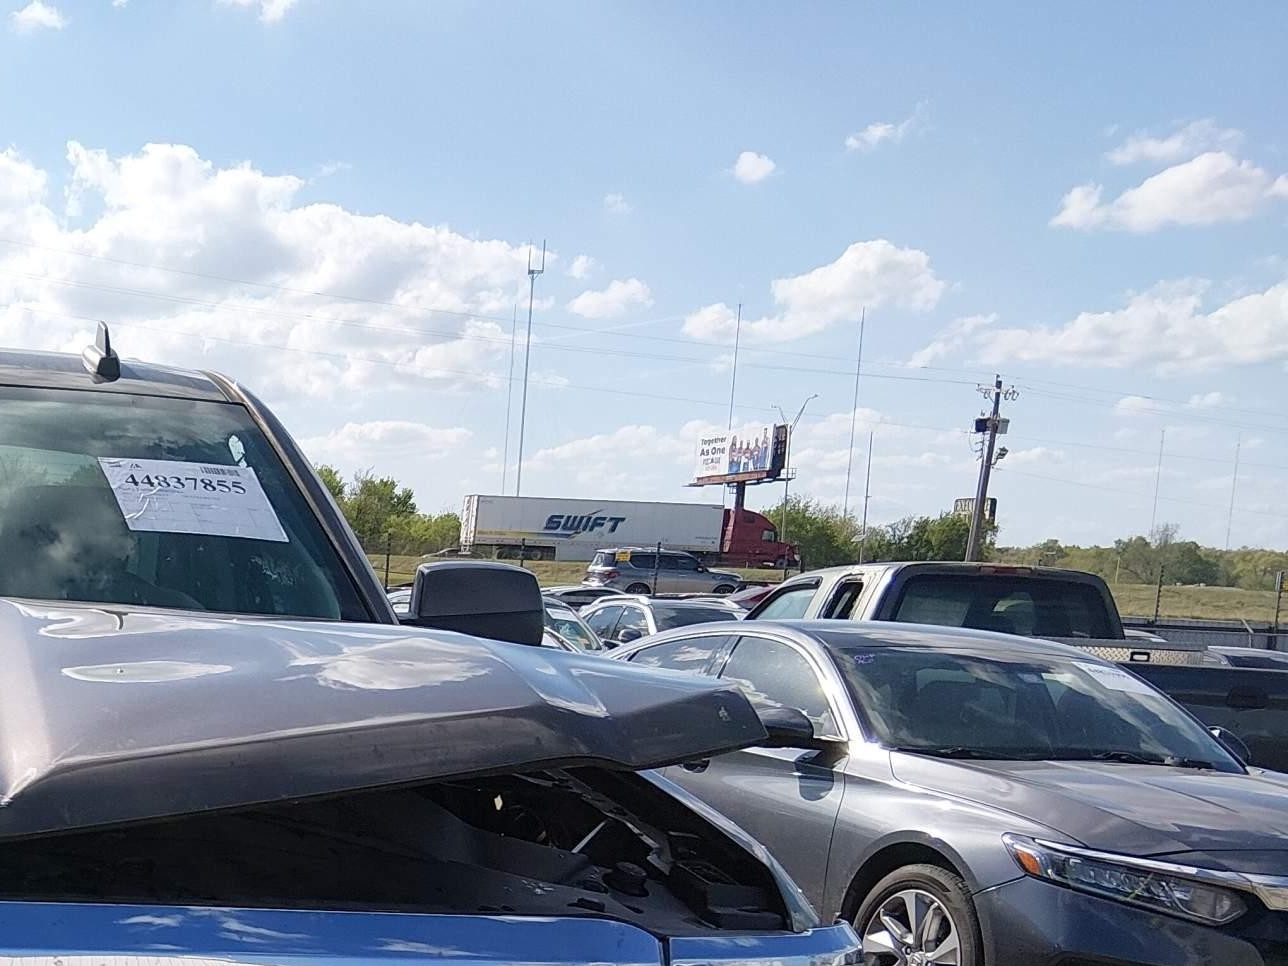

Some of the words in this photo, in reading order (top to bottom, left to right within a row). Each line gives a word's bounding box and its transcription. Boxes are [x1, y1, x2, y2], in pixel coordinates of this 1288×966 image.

[701, 437, 727, 446] Together
[700, 448, 710, 456] As
[711, 447, 726, 455] One
[125, 473, 247, 495] 44837855
[543, 514, 627, 534] SWIFT
